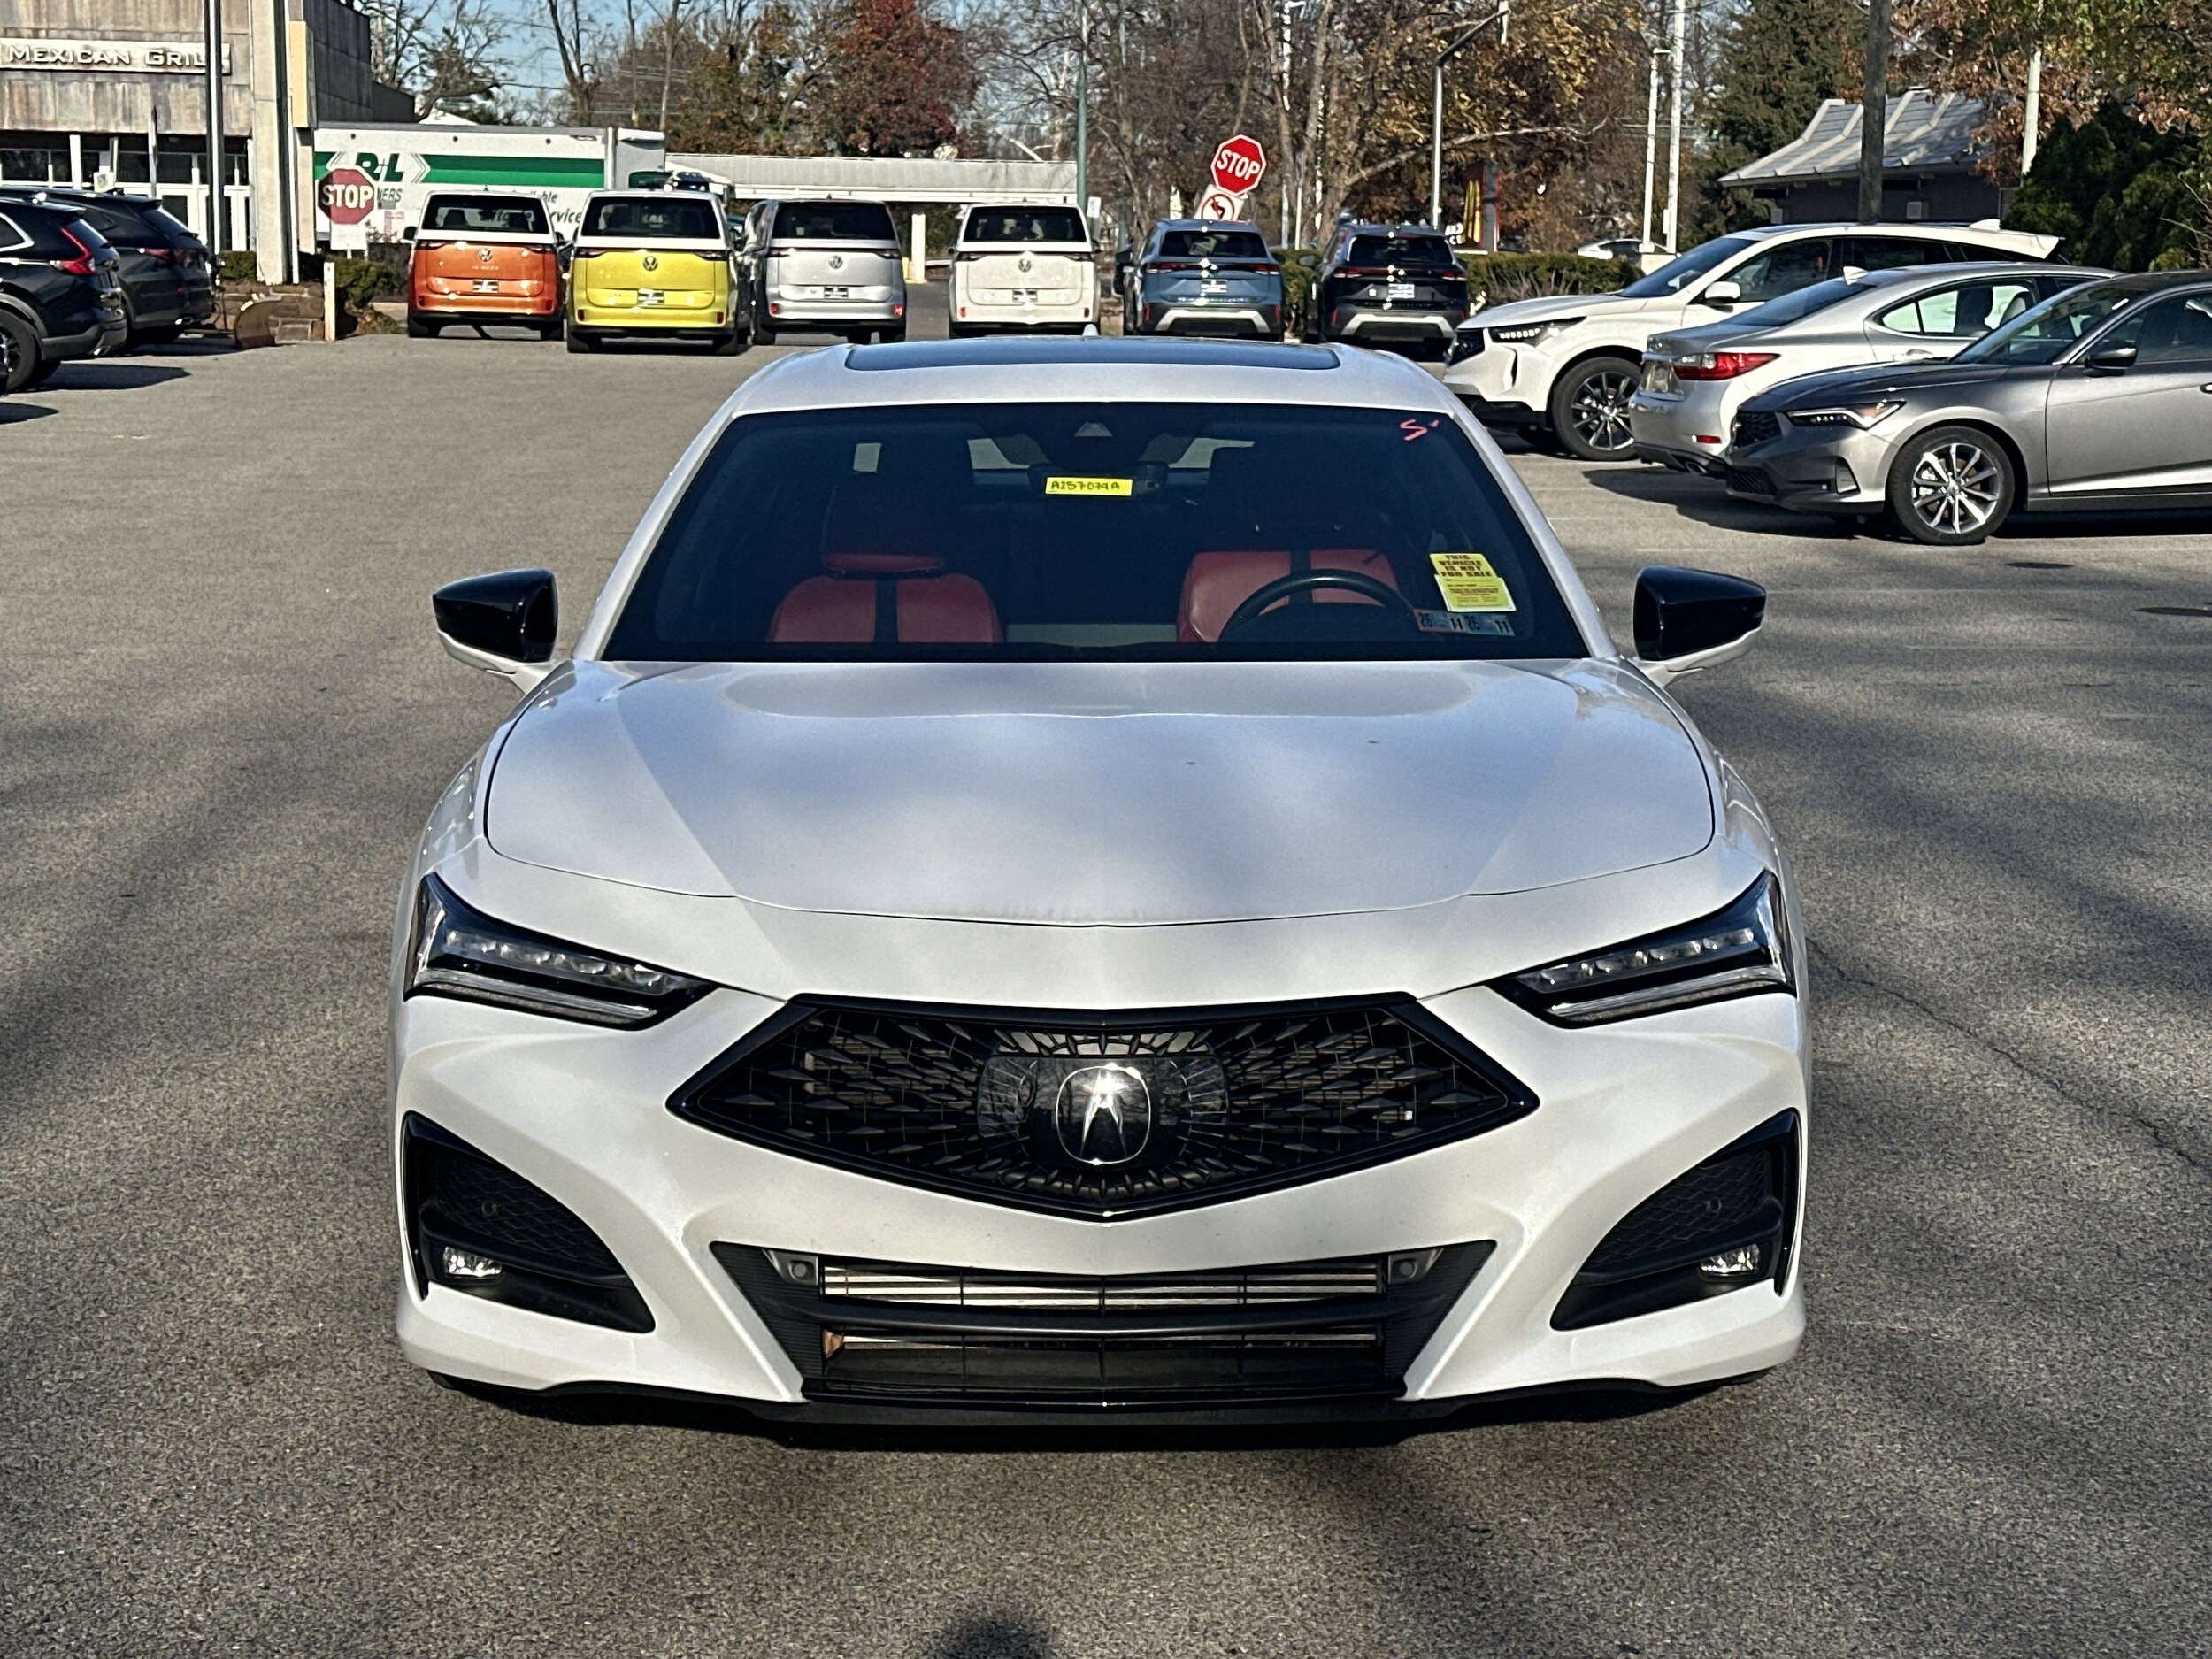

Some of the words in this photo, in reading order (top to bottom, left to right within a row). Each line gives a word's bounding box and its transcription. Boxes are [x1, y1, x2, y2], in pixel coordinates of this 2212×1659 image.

[8, 45, 131, 65] MEXICAN
[144, 49, 229, 66] GRIL
[1217, 149, 1261, 180] STOP
[321, 184, 373, 209] STOP
